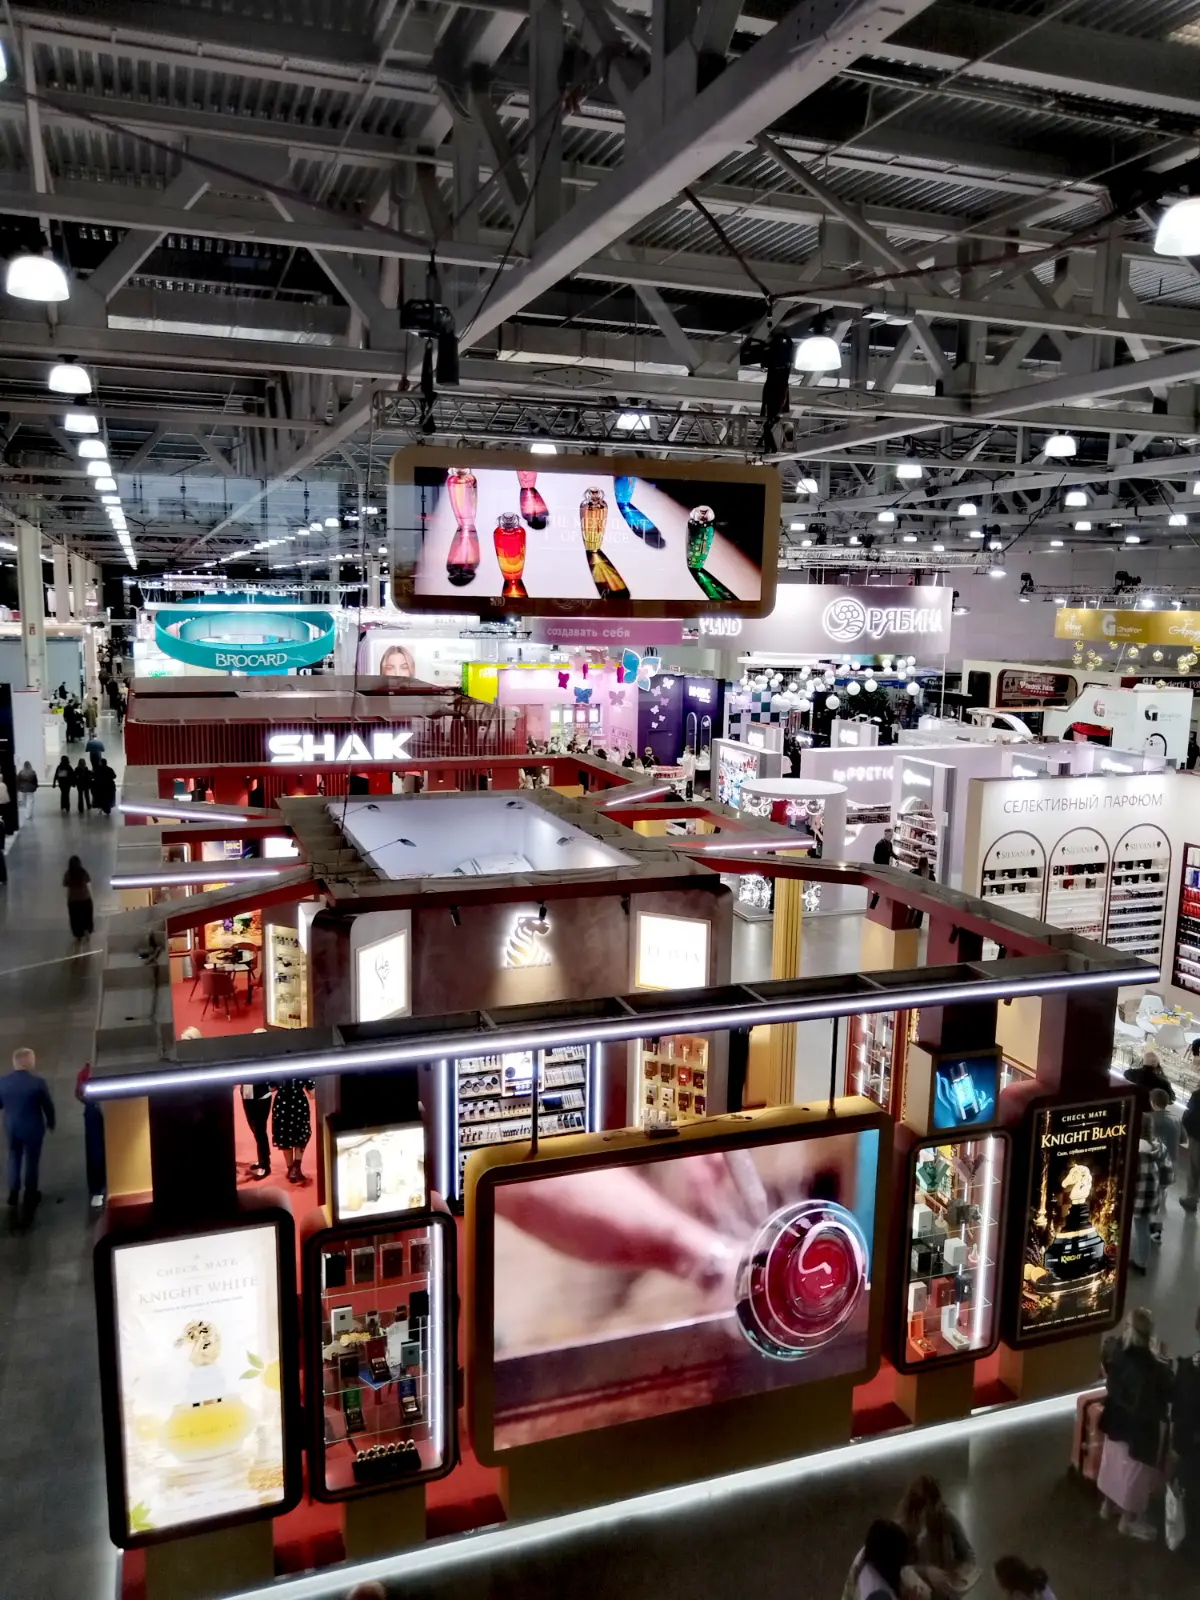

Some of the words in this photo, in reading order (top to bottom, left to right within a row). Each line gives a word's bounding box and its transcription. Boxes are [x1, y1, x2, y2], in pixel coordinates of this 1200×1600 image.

[547, 627, 598, 638] создавать
[603, 627, 631, 638] себя
[215, 653, 288, 667] BROCARD
[1003, 794, 1099, 813] СЕЛЕКТИВНЫЙ
[1104, 793, 1163, 808] ПАРФЮМ
[1001, 850, 1031, 859] SILVANA
[1061, 1113, 1086, 1123] CHECK
[1088, 1110, 1107, 1119] MATE
[1041, 1130, 1091, 1149] KNIGHT
[1092, 1124, 1127, 1140] BLACK
[157, 1264, 200, 1278] CHECK
[205, 1258, 239, 1270] MATE
[139, 1284, 203, 1305] KNIGHT
[208, 1275, 259, 1293] WHITE
